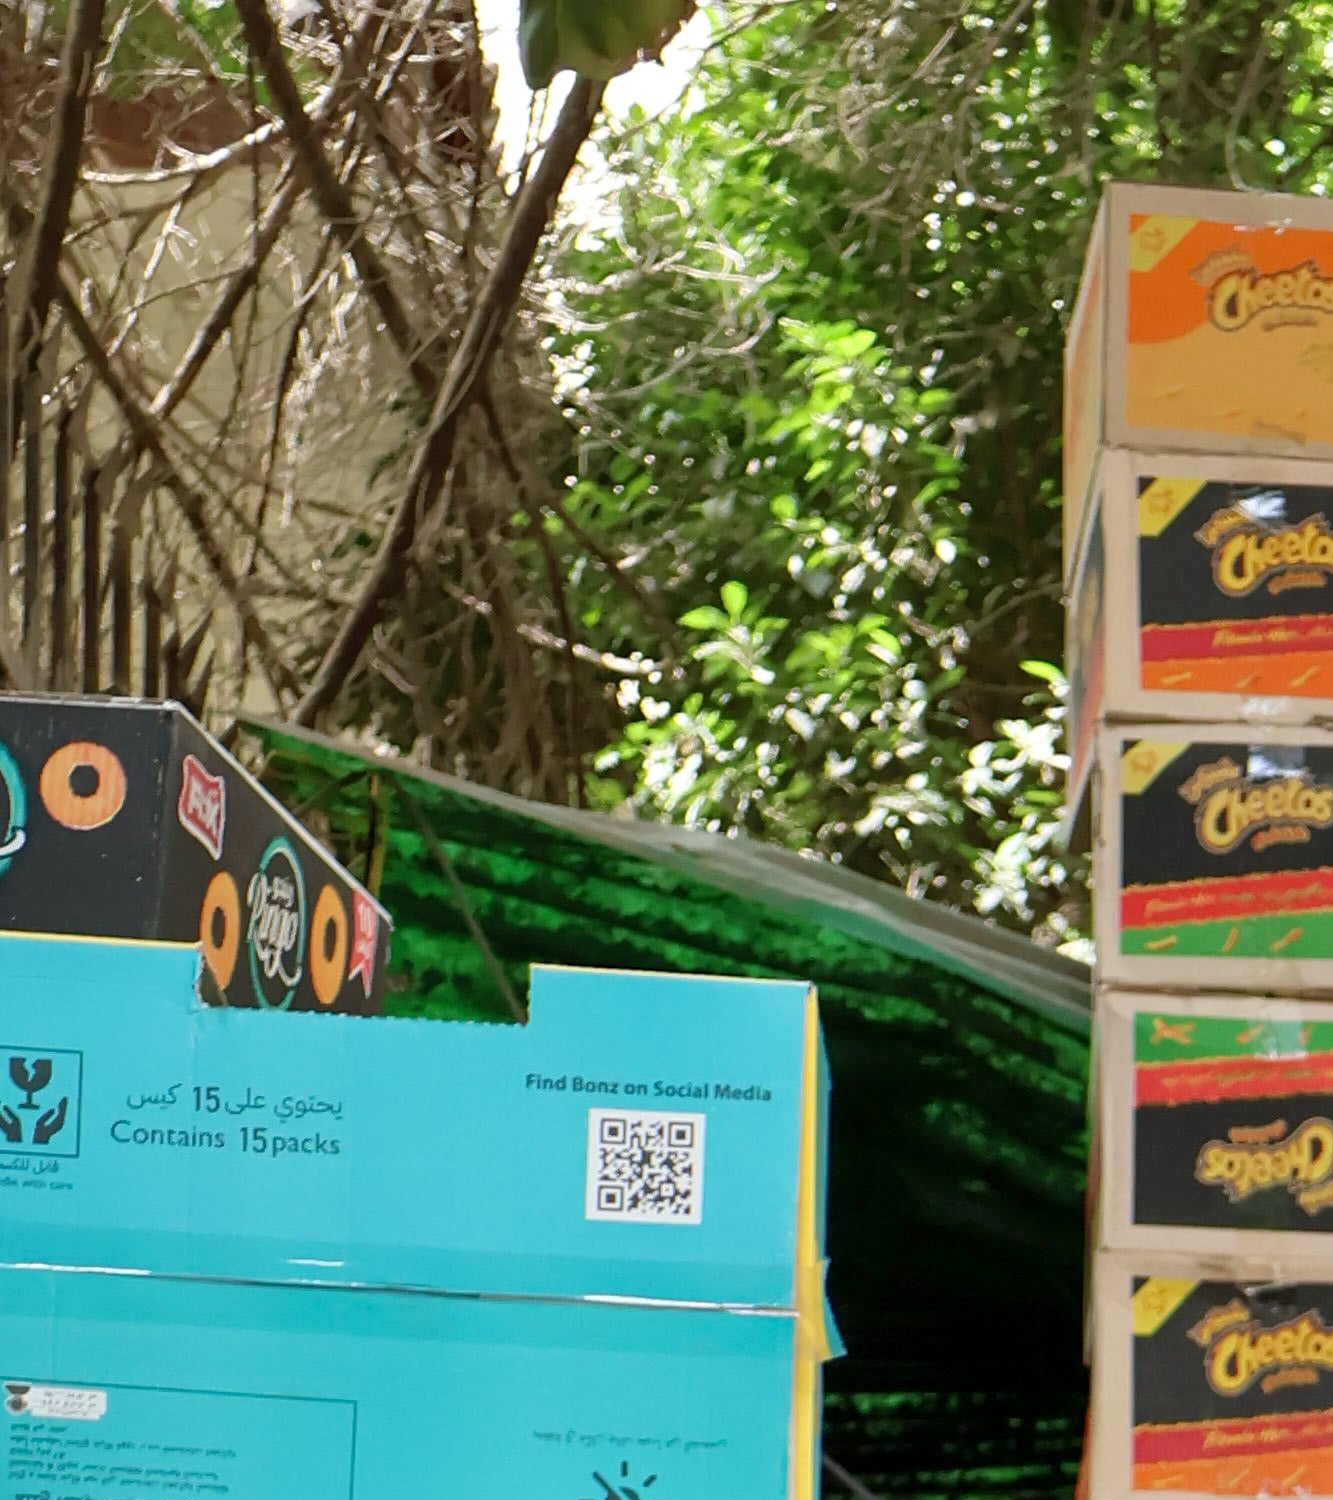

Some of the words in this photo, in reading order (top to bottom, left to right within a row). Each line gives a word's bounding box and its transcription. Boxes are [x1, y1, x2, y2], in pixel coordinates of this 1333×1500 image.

[126, 1083, 183, 1109] كيس
[193, 1086, 221, 1113] 15
[224, 1086, 266, 1115] على
[525, 1073, 567, 1090] Find
[572, 1076, 618, 1094] Bonz
[624, 1081, 648, 1096] on
[653, 1080, 709, 1099] Social
[714, 1083, 772, 1101] Media
[272, 1096, 344, 1124] يحتوي
[110, 1119, 226, 1149] Contains
[240, 1127, 268, 1154] 15
[272, 1131, 341, 1158] packs
